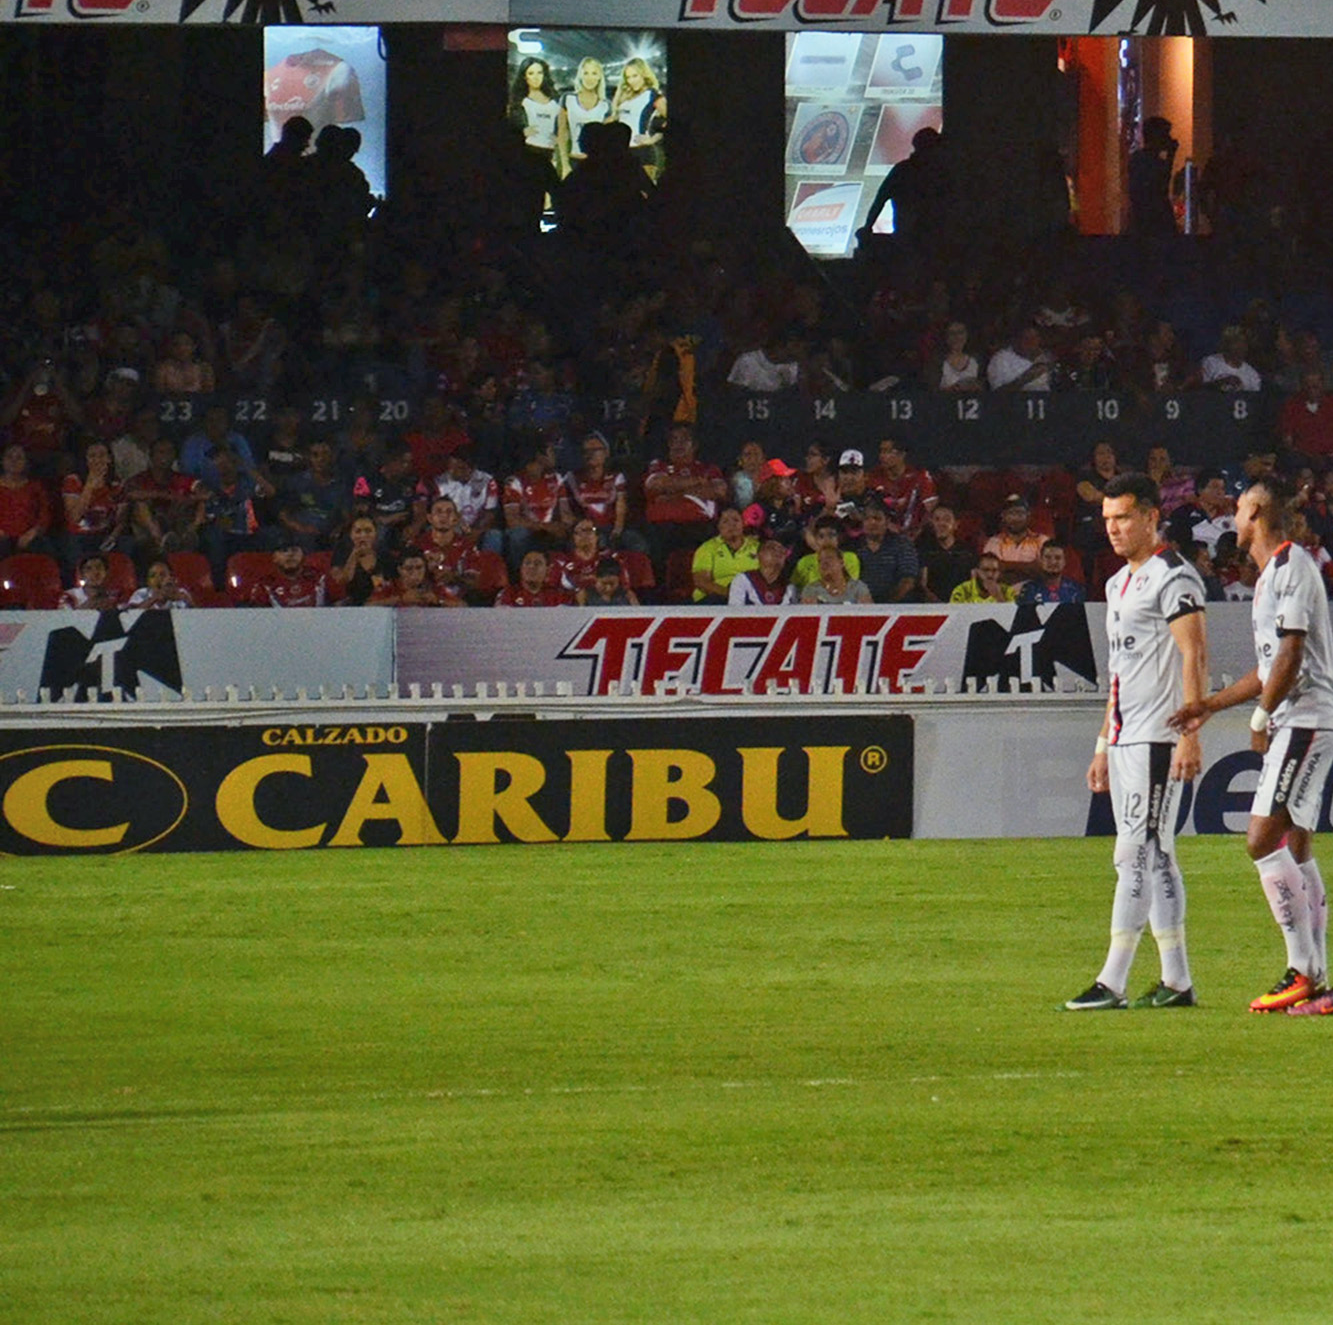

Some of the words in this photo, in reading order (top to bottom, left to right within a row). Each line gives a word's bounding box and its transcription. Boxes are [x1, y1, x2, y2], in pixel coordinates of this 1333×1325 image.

[162, 401, 193, 421] 23
[237, 401, 267, 421] 22
[313, 400, 339, 421] 21
[380, 400, 409, 421] 20
[748, 400, 770, 419] 15
[814, 399, 836, 420] 14
[890, 399, 913, 420] 13
[957, 399, 979, 420] 12
[1026, 399, 1045, 420] 11
[1096, 399, 1119, 420] 10
[1165, 399, 1180, 420] 9
[1234, 400, 1248, 419] 8
[556, 614, 949, 696] TECATE
[261, 725, 408, 745] CALZADO
[214, 744, 853, 850] CARIBU
[1124, 792, 1141, 819] 12
